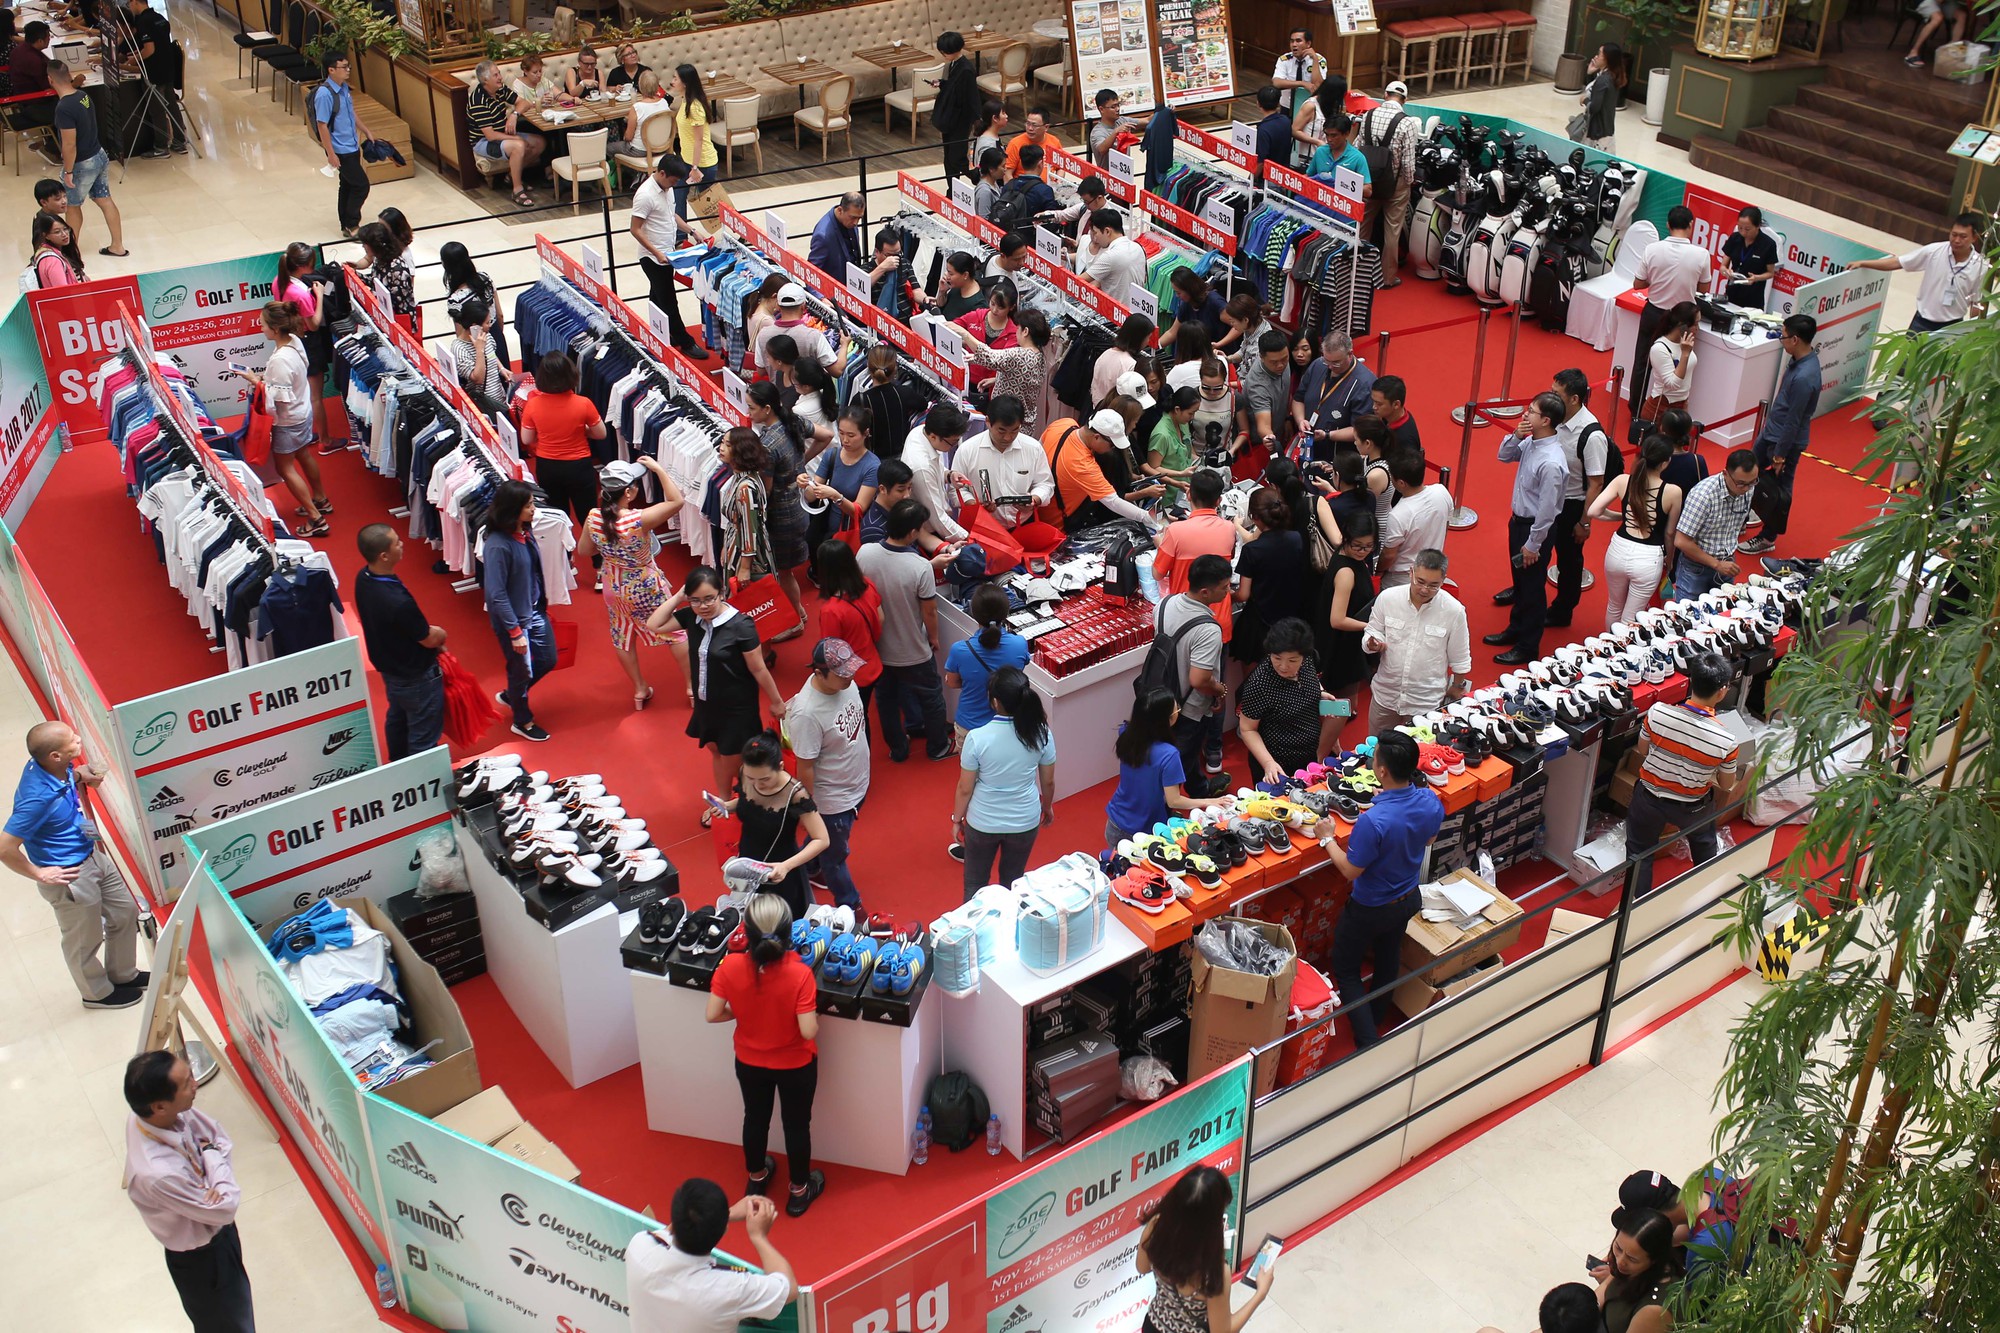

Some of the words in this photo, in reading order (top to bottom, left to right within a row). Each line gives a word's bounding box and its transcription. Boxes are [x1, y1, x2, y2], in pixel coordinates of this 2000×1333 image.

[1158, 2, 1191, 11] PREMIUM
[1160, 9, 1192, 21] STEAK
[1187, 130, 1202, 146] Sale
[1246, 134, 1250, 146] S
[1052, 150, 1064, 168] Big
[1066, 158, 1082, 175] Sale
[1216, 142, 1228, 159] Big
[1230, 149, 1246, 166] Sale
[1108, 178, 1126, 196] Sale
[1270, 166, 1283, 184] Big
[1284, 174, 1302, 192] Sale
[1350, 180, 1356, 192] S
[941, 201, 952, 220] Big
[953, 208, 968, 227] Sale
[1146, 198, 1159, 216] Big
[1160, 206, 1177, 224] Sale
[1318, 188, 1331, 206] Big
[1333, 194, 1352, 214] Sale
[1218, 212, 1230, 226] S33
[980, 224, 992, 244] Big
[1192, 220, 1206, 239] Big
[1207, 228, 1224, 248] Sale
[1046, 241, 1058, 256] S31
[1788, 244, 1817, 268] GOLF
[794, 260, 804, 280] Big
[806, 269, 821, 289] Sale
[1036, 258, 1052, 278] Sale
[195, 288, 234, 308] GOLF
[834, 286, 846, 307] Big
[847, 296, 863, 318] Sale
[1067, 277, 1079, 298] Big
[1081, 287, 1098, 308] Sale
[1818, 294, 1840, 314] GOLF
[1842, 286, 1862, 305] FAIR
[1864, 278, 1884, 297] 2017
[1142, 300, 1154, 316] S30
[58, 316, 126, 357] Big
[152, 328, 172, 338] Nov
[220, 316, 242, 328] 2017
[877, 316, 888, 336] Big
[890, 324, 906, 348] Sale
[229, 342, 264, 356] Cleveland
[921, 346, 933, 366] Big
[935, 355, 952, 380] Sale
[744, 598, 774, 618] RIXON
[188, 702, 242, 734] GOLF
[248, 686, 299, 716] FAIR
[305, 668, 352, 700] 2017
[328, 728, 354, 746] NIKE
[236, 752, 288, 776] Cleveland
[252, 766, 277, 777] GOLF
[148, 795, 185, 812] adidas
[210, 784, 296, 820] TaylorMade
[267, 820, 324, 856] GOLF
[332, 800, 385, 833] FAIR
[392, 778, 440, 812] 2017
[318, 870, 372, 899] Cleveland
[335, 885, 362, 898] GOLF
[317, 1106, 362, 1192] 2017
[386, 1154, 438, 1184] adidas
[1064, 1170, 1122, 1218] GOLF
[1130, 1139, 1180, 1182] FAIR
[1187, 1108, 1237, 1151] 2017
[395, 1198, 454, 1240] PUMA
[538, 1213, 626, 1262] Cleveland
[990, 1270, 1019, 1292] Nov
[1024, 1229, 1086, 1274] 24-25-26,
[1091, 1209, 1126, 1235] 2017
[566, 1240, 607, 1262] GOLF
[1096, 1243, 1140, 1274] Clevelan
[434, 1262, 454, 1278] The
[456, 1273, 480, 1290] Mark
[484, 1288, 494, 1297] of
[506, 1298, 538, 1318] Player
[508, 1247, 630, 1317] TaylorMa
